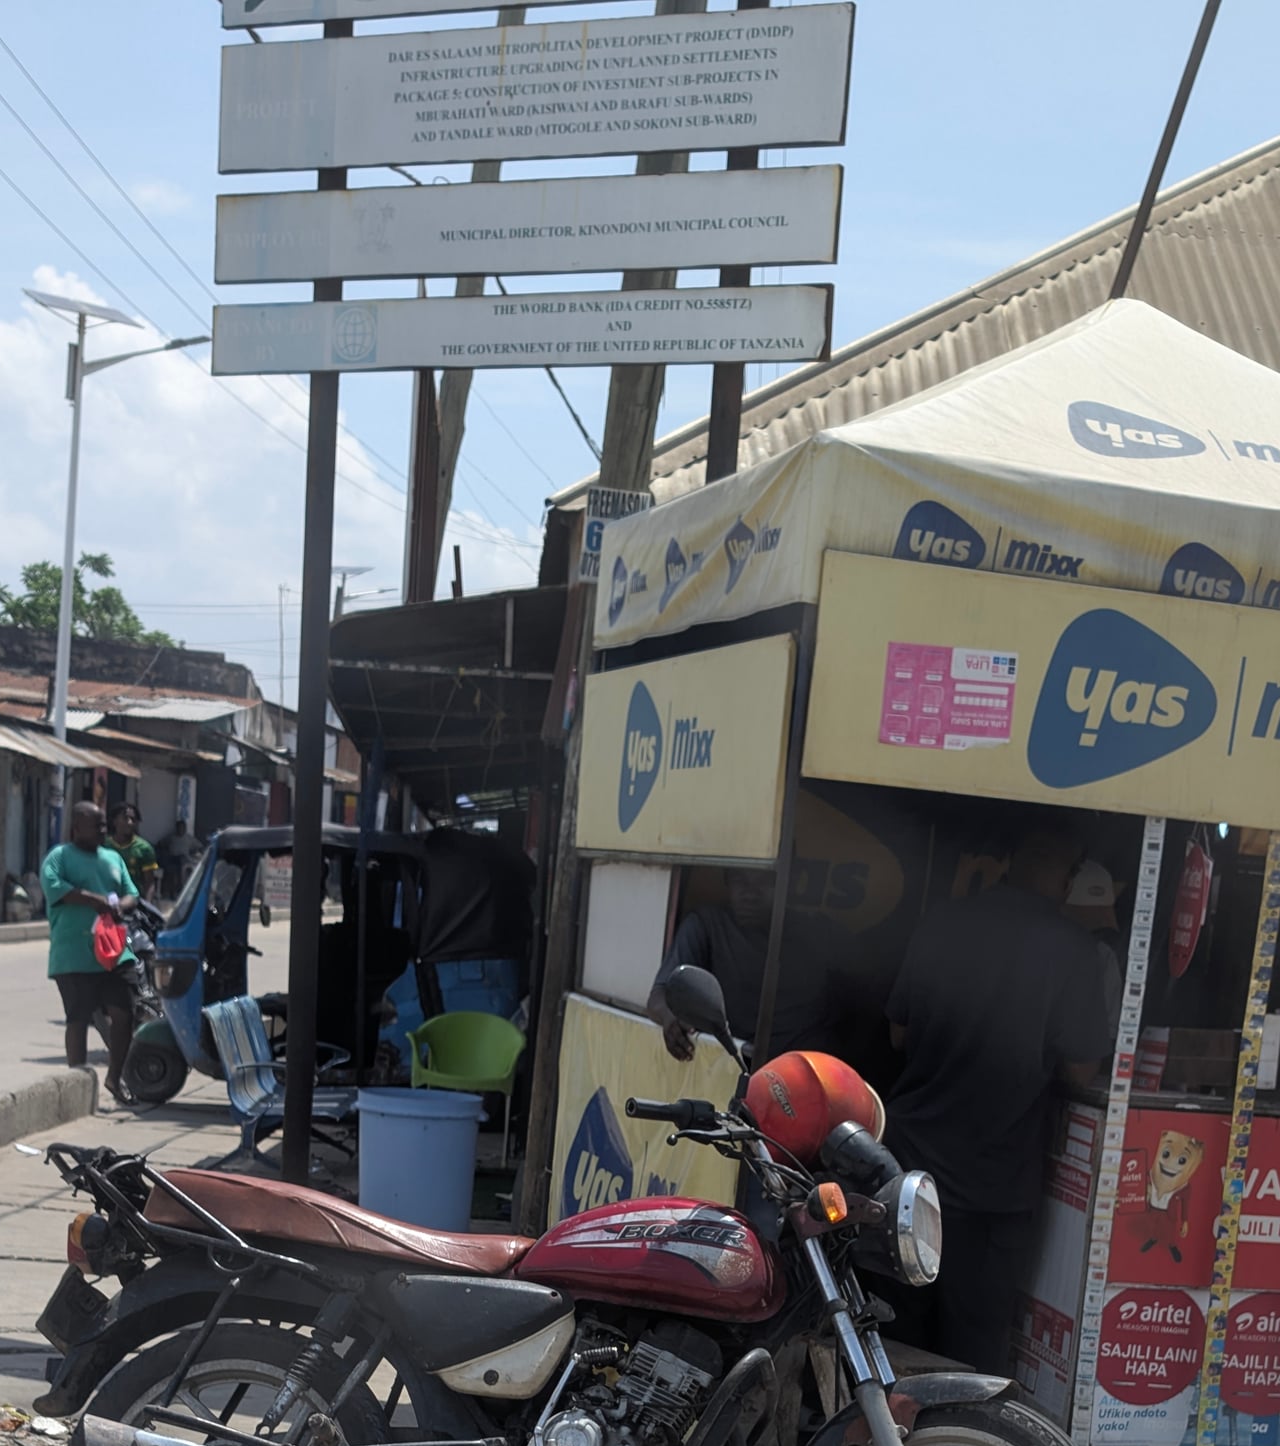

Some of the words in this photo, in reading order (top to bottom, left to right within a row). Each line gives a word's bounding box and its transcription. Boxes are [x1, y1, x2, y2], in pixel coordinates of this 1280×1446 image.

[388, 50, 414, 63] DAR
[416, 50, 431, 61] ES
[432, 46, 482, 60] SALAAM
[484, 40, 584, 57] METROPOLITAN
[586, 32, 682, 49] DEVELOPMENT
[684, 28, 744, 43] PROJECT
[746, 25, 794, 41] (DMDP)
[400, 64, 508, 83] INFRASTRUCTURE
[510, 59, 584, 76] UPGRADING
[586, 58, 600, 70] IN
[603, 53, 681, 71] UNPLANNED
[682, 47, 778, 65] SETTLEMENTS
[394, 90, 450, 104] PACKAGE
[464, 81, 560, 100] CONSTRUCTION
[563, 80, 580, 93] OF
[582, 76, 665, 92] INVESTMENT
[667, 71, 762, 88] SUB-PROJECTS
[764, 69, 779, 81] IN
[416, 107, 486, 123] MBURAHATI
[489, 104, 525, 119] WARD
[526, 101, 589, 117] (KISIWANI
[592, 100, 618, 112] AND
[620, 97, 670, 111] BARAFU
[673, 92, 753, 109] SUB-WARDS)
[411, 130, 436, 143] AND
[440, 127, 494, 142] TANDALE
[496, 124, 533, 138] WARD
[535, 121, 602, 137] (MTOGOLE
[604, 119, 631, 132] AND
[633, 116, 683, 131] SOKONI
[685, 112, 758, 127] SUB-WARD)
[440, 228, 507, 242] MUNICIPAL
[508, 225, 576, 239] DIRECTOR,
[578, 222, 652, 237] KINONDONI
[654, 218, 727, 233] MUNICIPAL
[728, 215, 789, 230] COUNCIL
[493, 304, 517, 316] THE
[519, 302, 566, 315] WORLD
[568, 301, 604, 313] BANK
[605, 300, 633, 313] (IDA
[635, 299, 682, 311] CREDIT
[606, 320, 632, 332] AND
[440, 344, 464, 356] THE
[467, 342, 555, 355] GOVERNMENT
[556, 341, 573, 353] OF
[575, 340, 602, 352] THE
[604, 339, 650, 352] UNITED
[653, 338, 718, 351] REPUBLIC
[719, 338, 738, 350] OF
[740, 337, 805, 350] TANZANIA
[615, 1223, 748, 1246] BOXER
[1237, 1221, 1274, 1236] AJILI
[1140, 1302, 1192, 1325] airtel
[1123, 1324, 1149, 1333] REASON
[1160, 1326, 1190, 1335] IMAGINE
[1240, 1334, 1266, 1342] REASON
[1267, 1335, 1276, 1343] TO
[1100, 1342, 1152, 1361] SAJILI
[1154, 1346, 1197, 1363] LAINI
[1125, 1361, 1168, 1377] HAPA
[1098, 1407, 1131, 1419] Ufikie
[1133, 1408, 1167, 1418] ndoto
[1097, 1421, 1129, 1434] yako!
